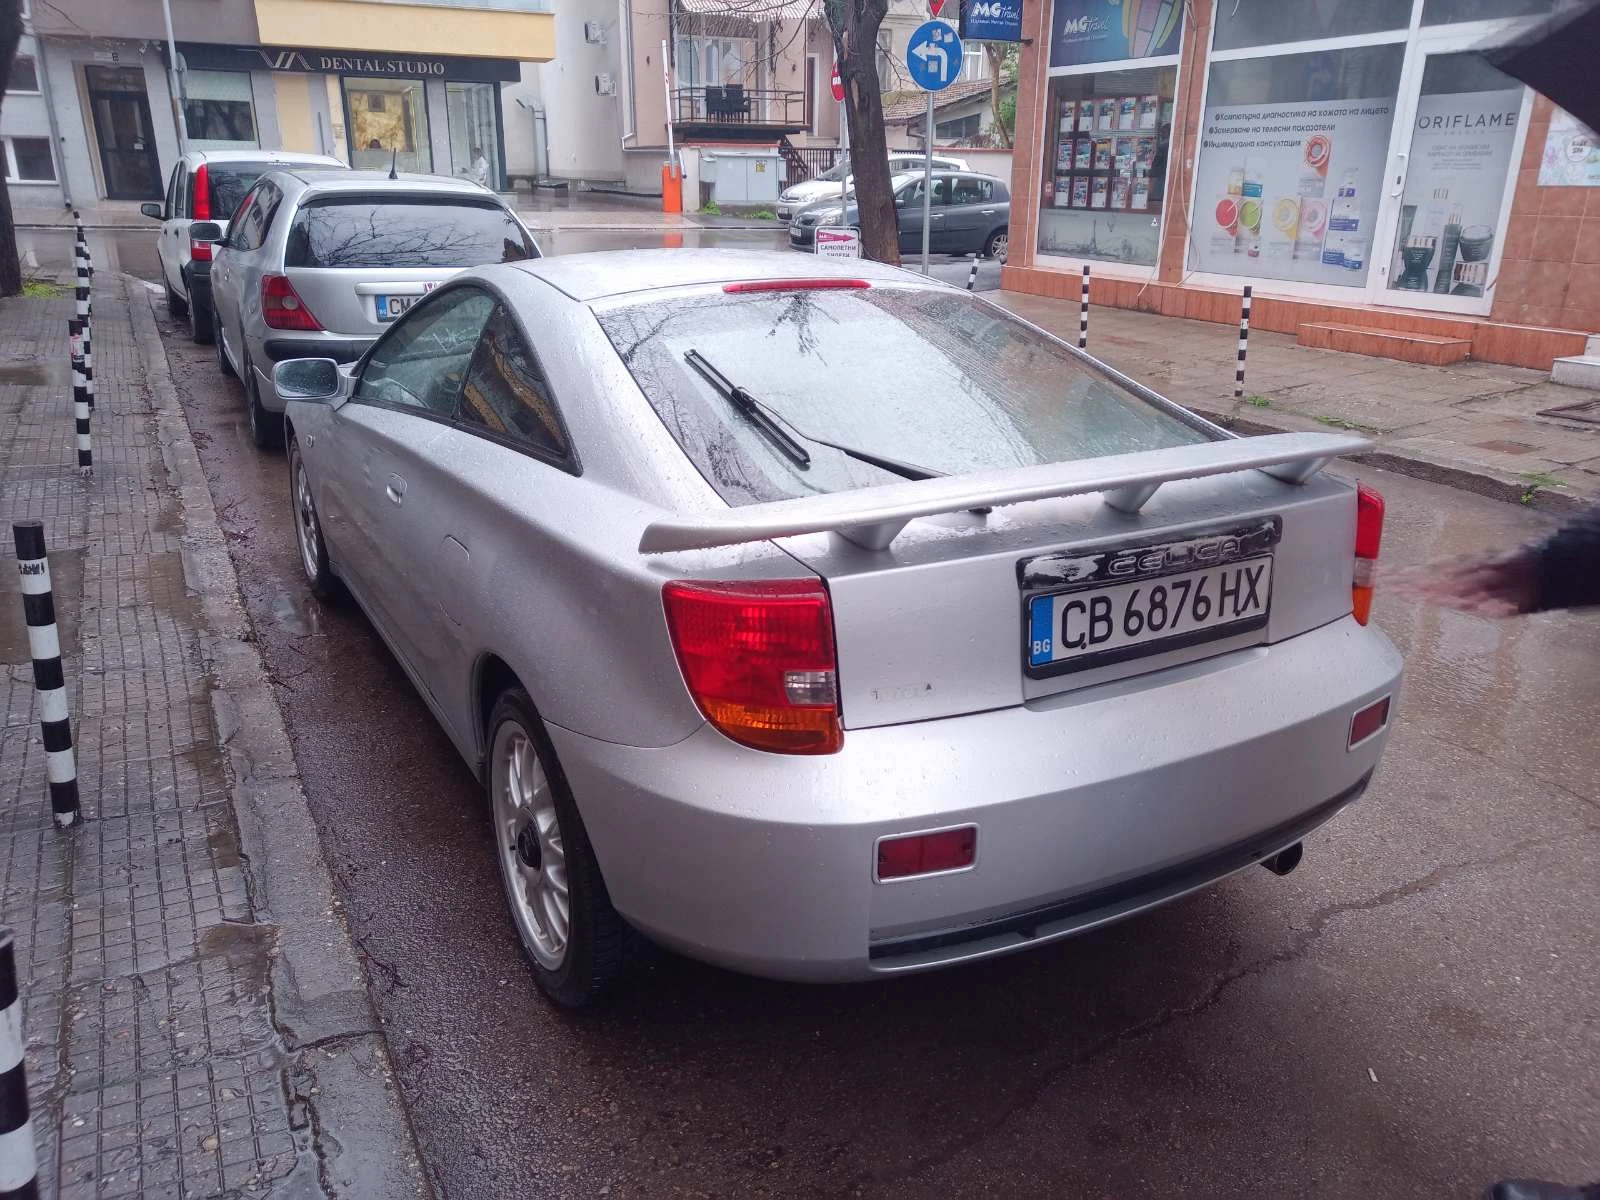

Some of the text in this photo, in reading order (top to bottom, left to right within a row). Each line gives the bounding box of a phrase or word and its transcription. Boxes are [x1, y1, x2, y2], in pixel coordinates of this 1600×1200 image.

[970, 1, 1001, 18] MG
[1064, 15, 1088, 34] MG
[320, 56, 445, 75] DENTAL STUDIO
[1262, 110, 1307, 120] диагностика
[1308, 110, 1317, 118] на
[1319, 109, 1348, 117] кожата
[1361, 107, 1390, 116] лицето
[1418, 112, 1517, 129] ORIFLAME
[1213, 126, 1251, 135] Замерване
[1263, 125, 1291, 133] телесни
[1292, 124, 1336, 132] показатели
[1108, 537, 1241, 576] CELICA
[1061, 564, 1265, 650] CB 6876 HX
[1033, 638, 1051, 656] BG
